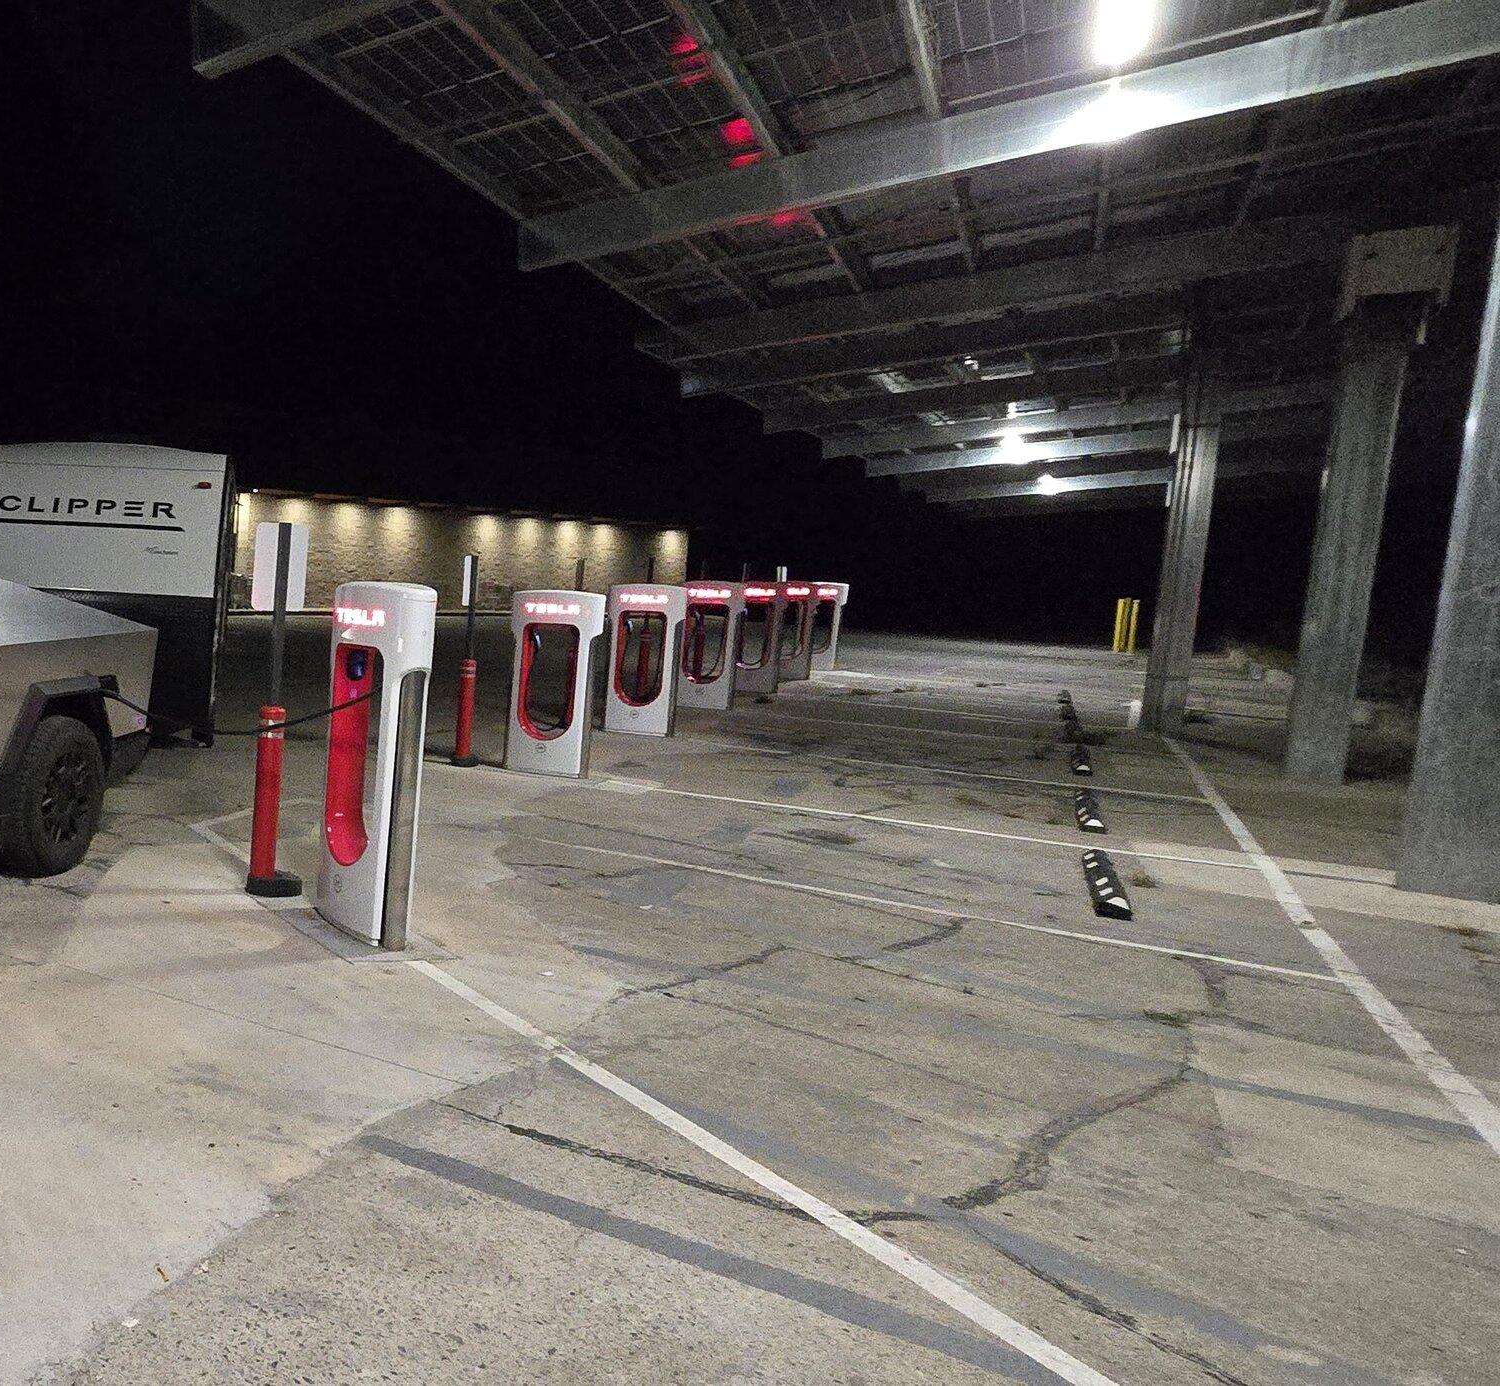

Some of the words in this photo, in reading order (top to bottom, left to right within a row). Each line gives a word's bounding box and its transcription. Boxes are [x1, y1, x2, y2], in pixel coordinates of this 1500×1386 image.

[0, 495, 176, 519] CLIPPER
[334, 606, 386, 627] TESLA
[525, 602, 581, 615] TESLA
